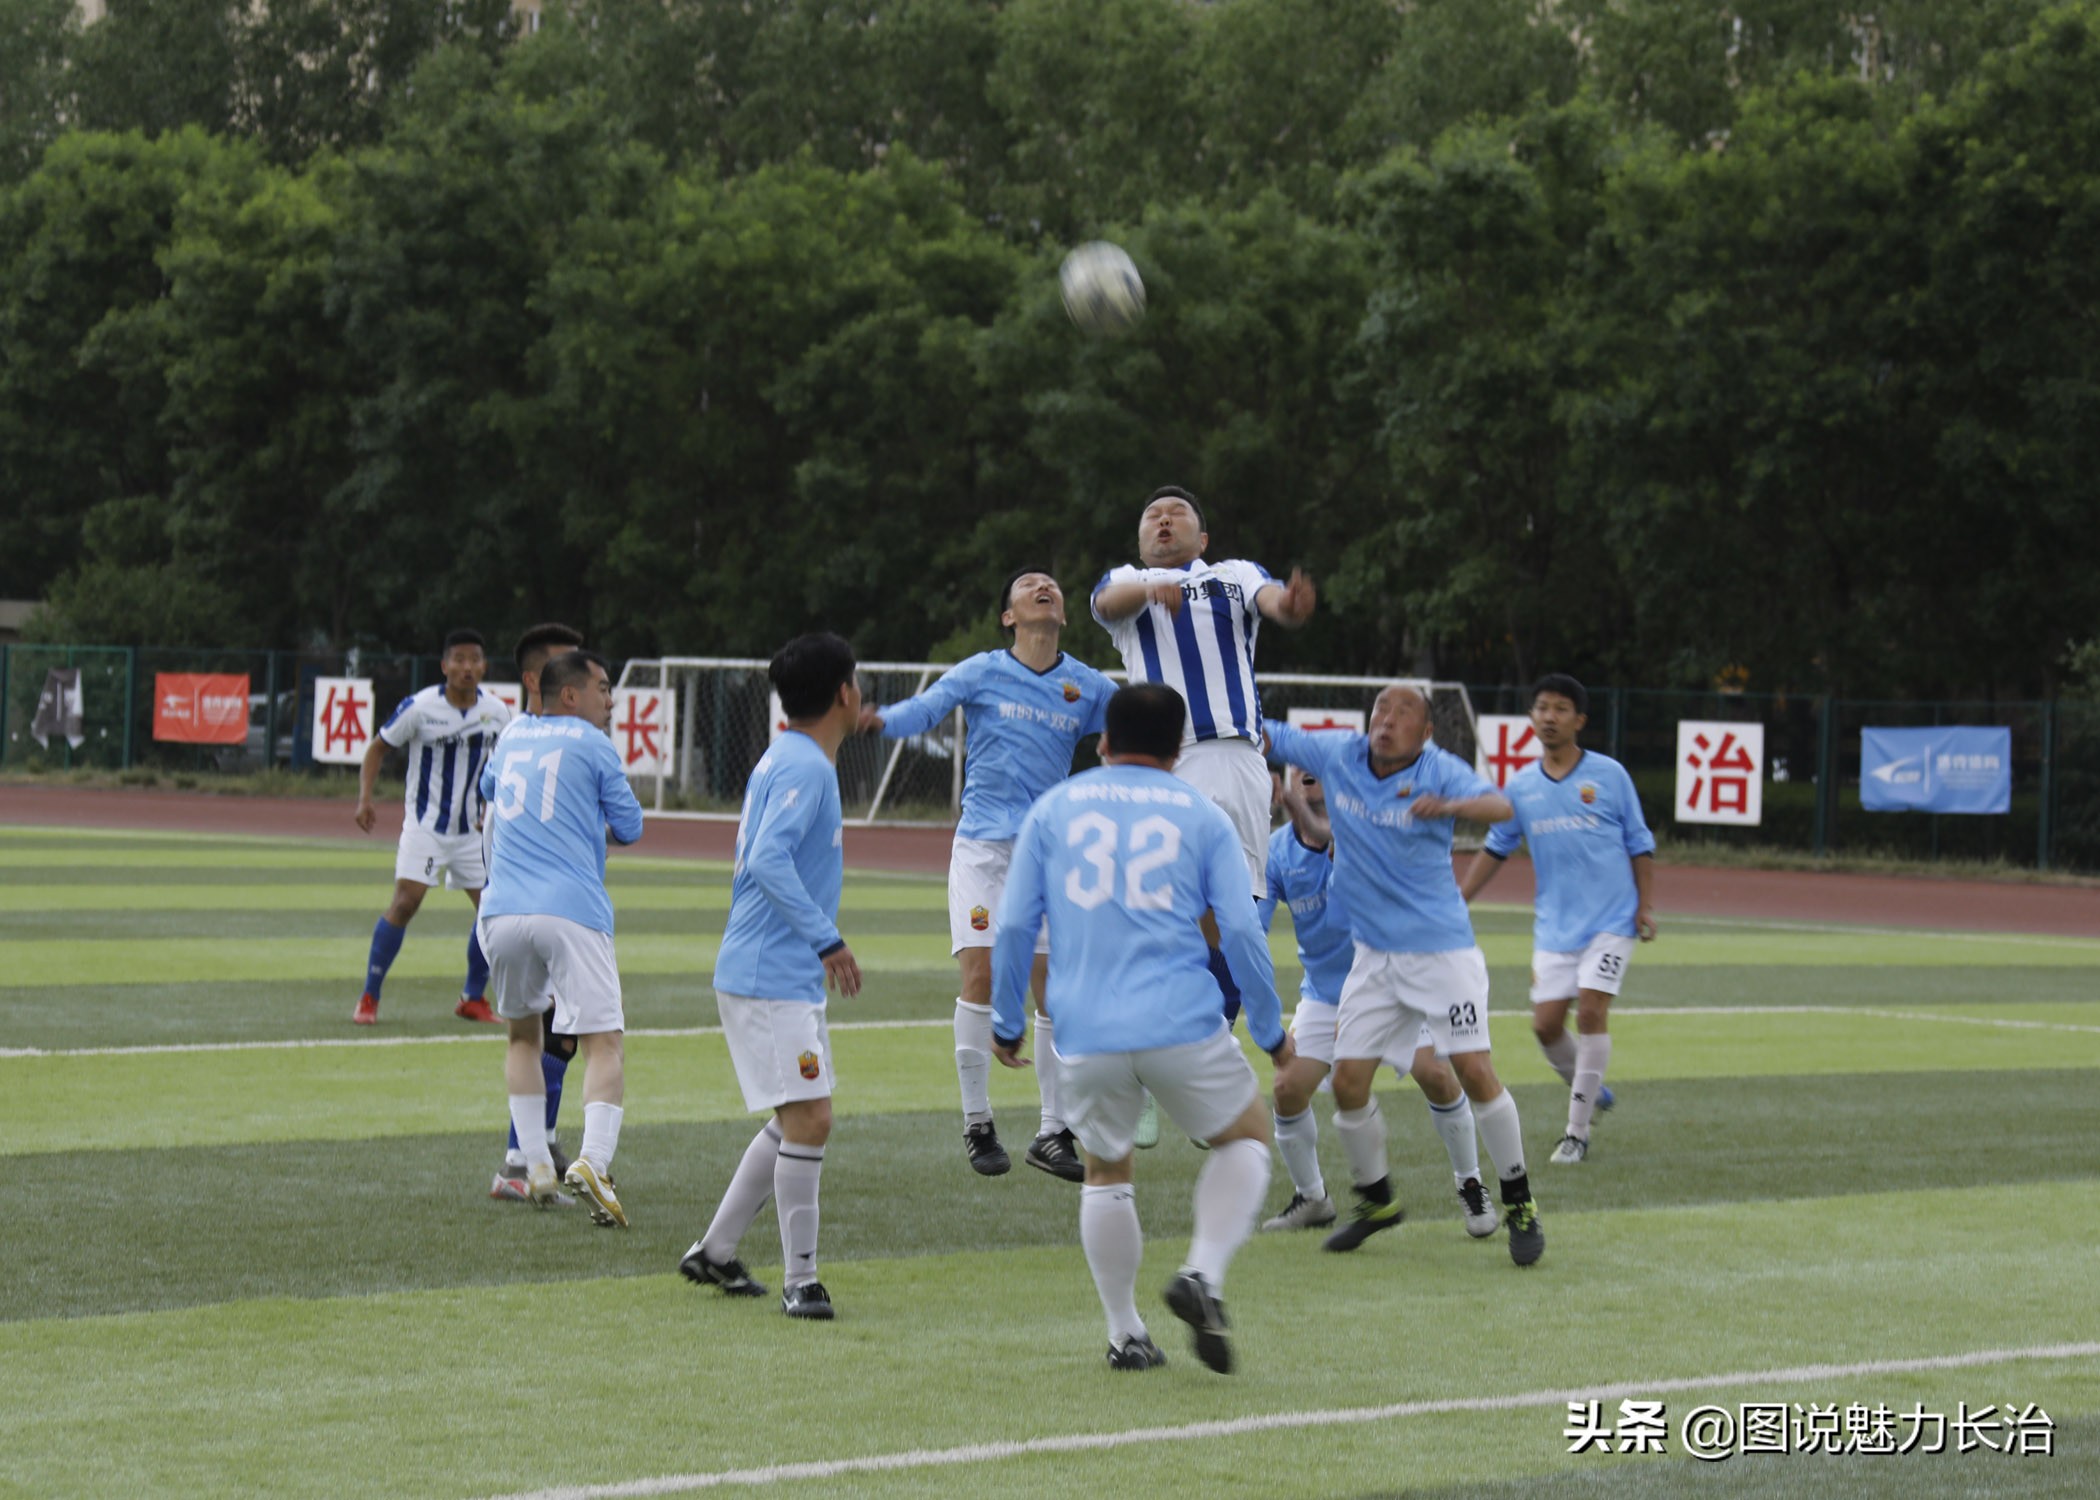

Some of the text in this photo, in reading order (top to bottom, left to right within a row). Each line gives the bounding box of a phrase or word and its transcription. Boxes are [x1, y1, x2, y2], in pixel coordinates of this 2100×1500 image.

[320, 686, 368, 754] 体
[617, 695, 668, 766] 长
[497, 747, 563, 822] 51
[1686, 732, 1755, 815] 治
[425, 856, 434, 876] 8
[1065, 811, 1182, 911] 32
[1598, 953, 1623, 975] 55
[1449, 1001, 1477, 1026] 23
